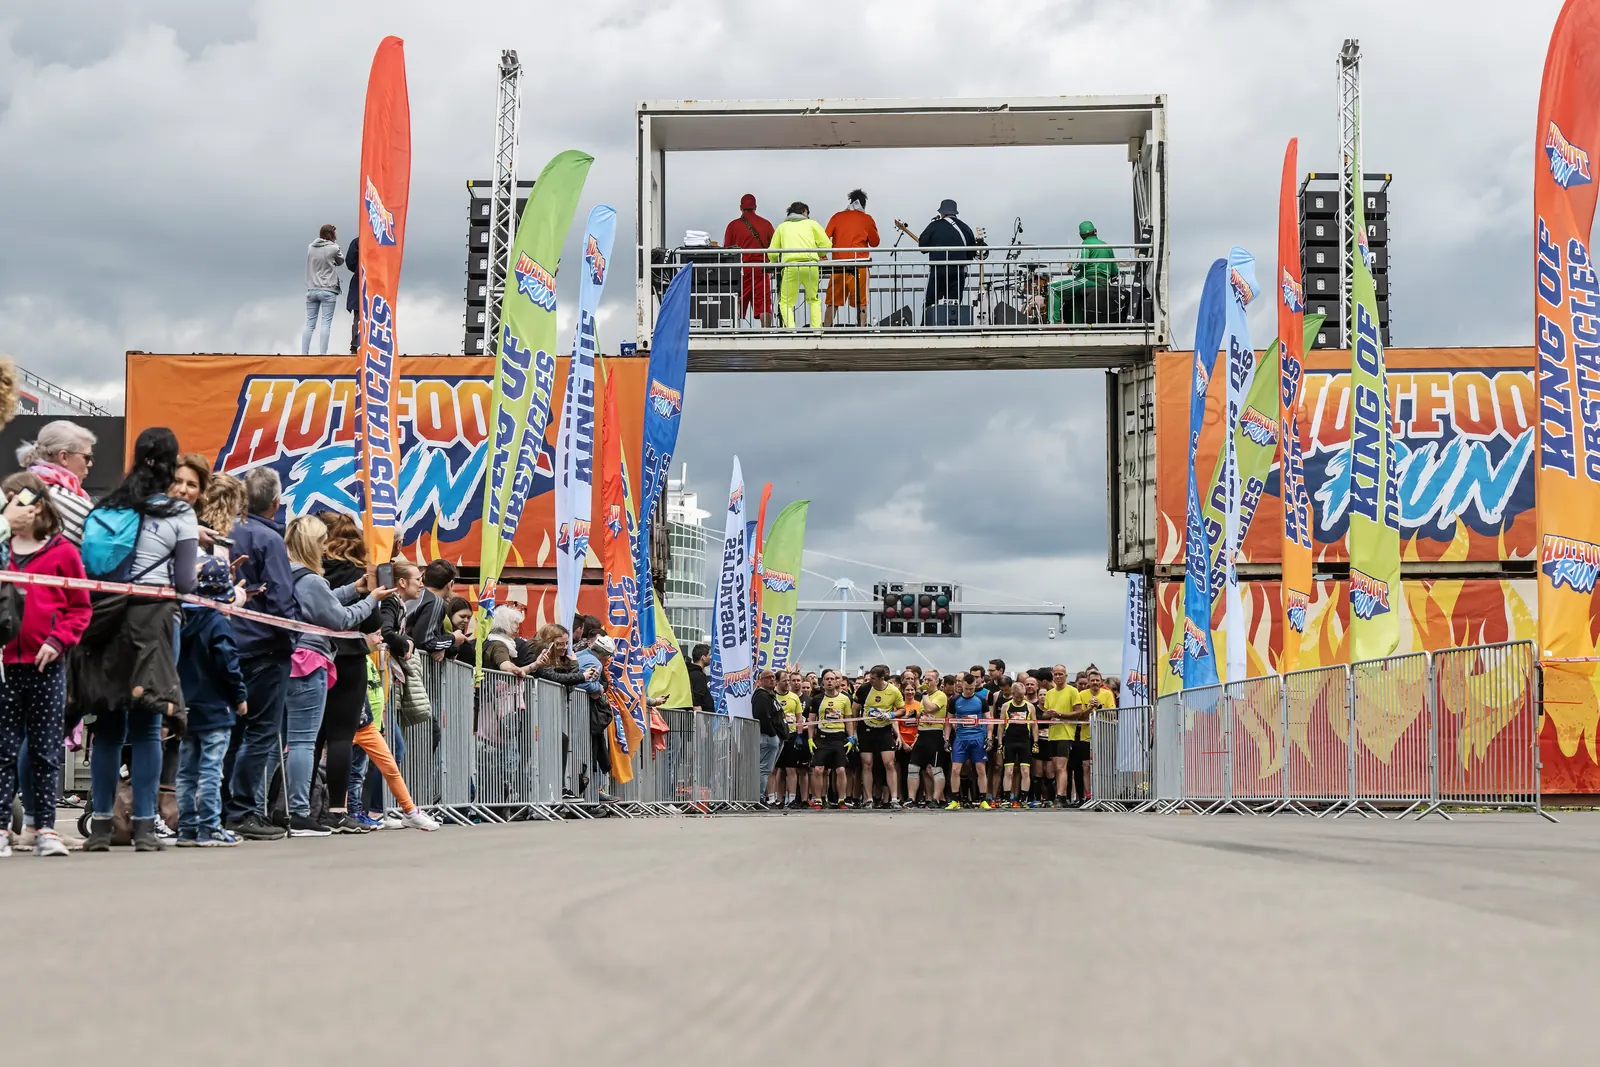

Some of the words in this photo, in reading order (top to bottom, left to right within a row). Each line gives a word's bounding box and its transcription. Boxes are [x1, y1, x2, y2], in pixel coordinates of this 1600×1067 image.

[515, 250, 556, 296] HOTFO
[1537, 214, 1562, 309] OF
[1356, 301, 1380, 378] OF
[1537, 313, 1577, 480] KING
[1349, 383, 1381, 524] KING
[1542, 534, 1600, 566] HOTFOO
[1554, 558, 1600, 593] RUN
